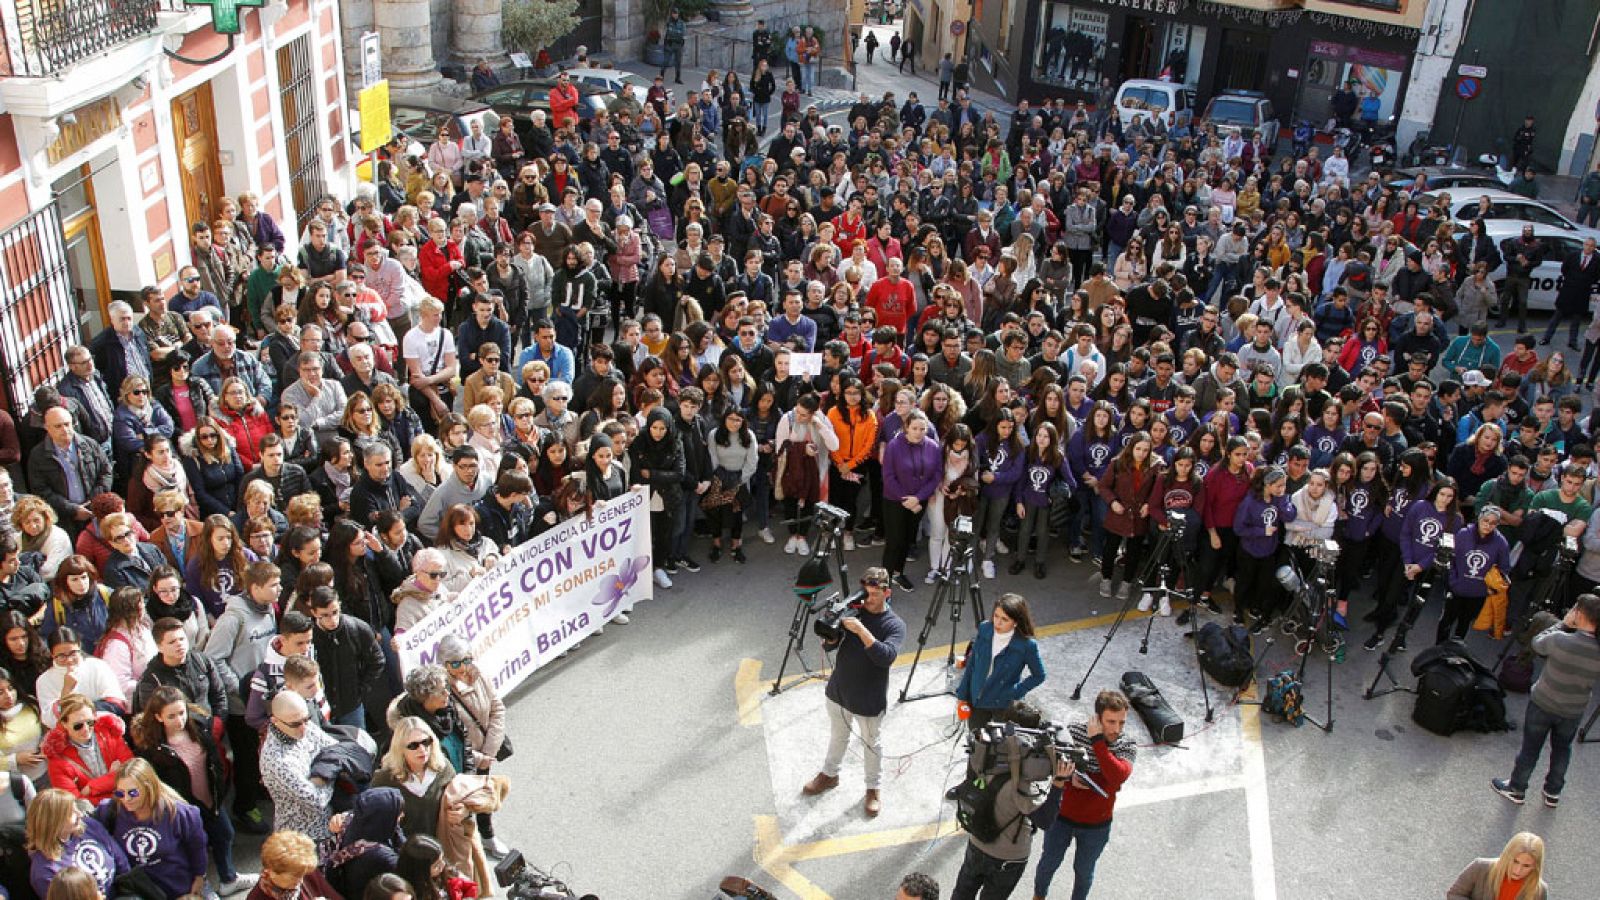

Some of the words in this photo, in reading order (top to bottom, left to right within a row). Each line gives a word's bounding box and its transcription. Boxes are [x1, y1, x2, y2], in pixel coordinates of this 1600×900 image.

[406, 601, 466, 650] ASOCIACO
[505, 558, 517, 574] LA
[520, 525, 578, 564] VIOLENCIA
[598, 494, 643, 524] GENERO
[420, 581, 513, 665] MERES
[520, 546, 573, 593] CON
[581, 517, 632, 560] VOZ
[535, 591, 550, 610] MI
[554, 557, 616, 598] SONRISA
[492, 649, 531, 690] arina
[536, 612, 590, 654] Baixa
